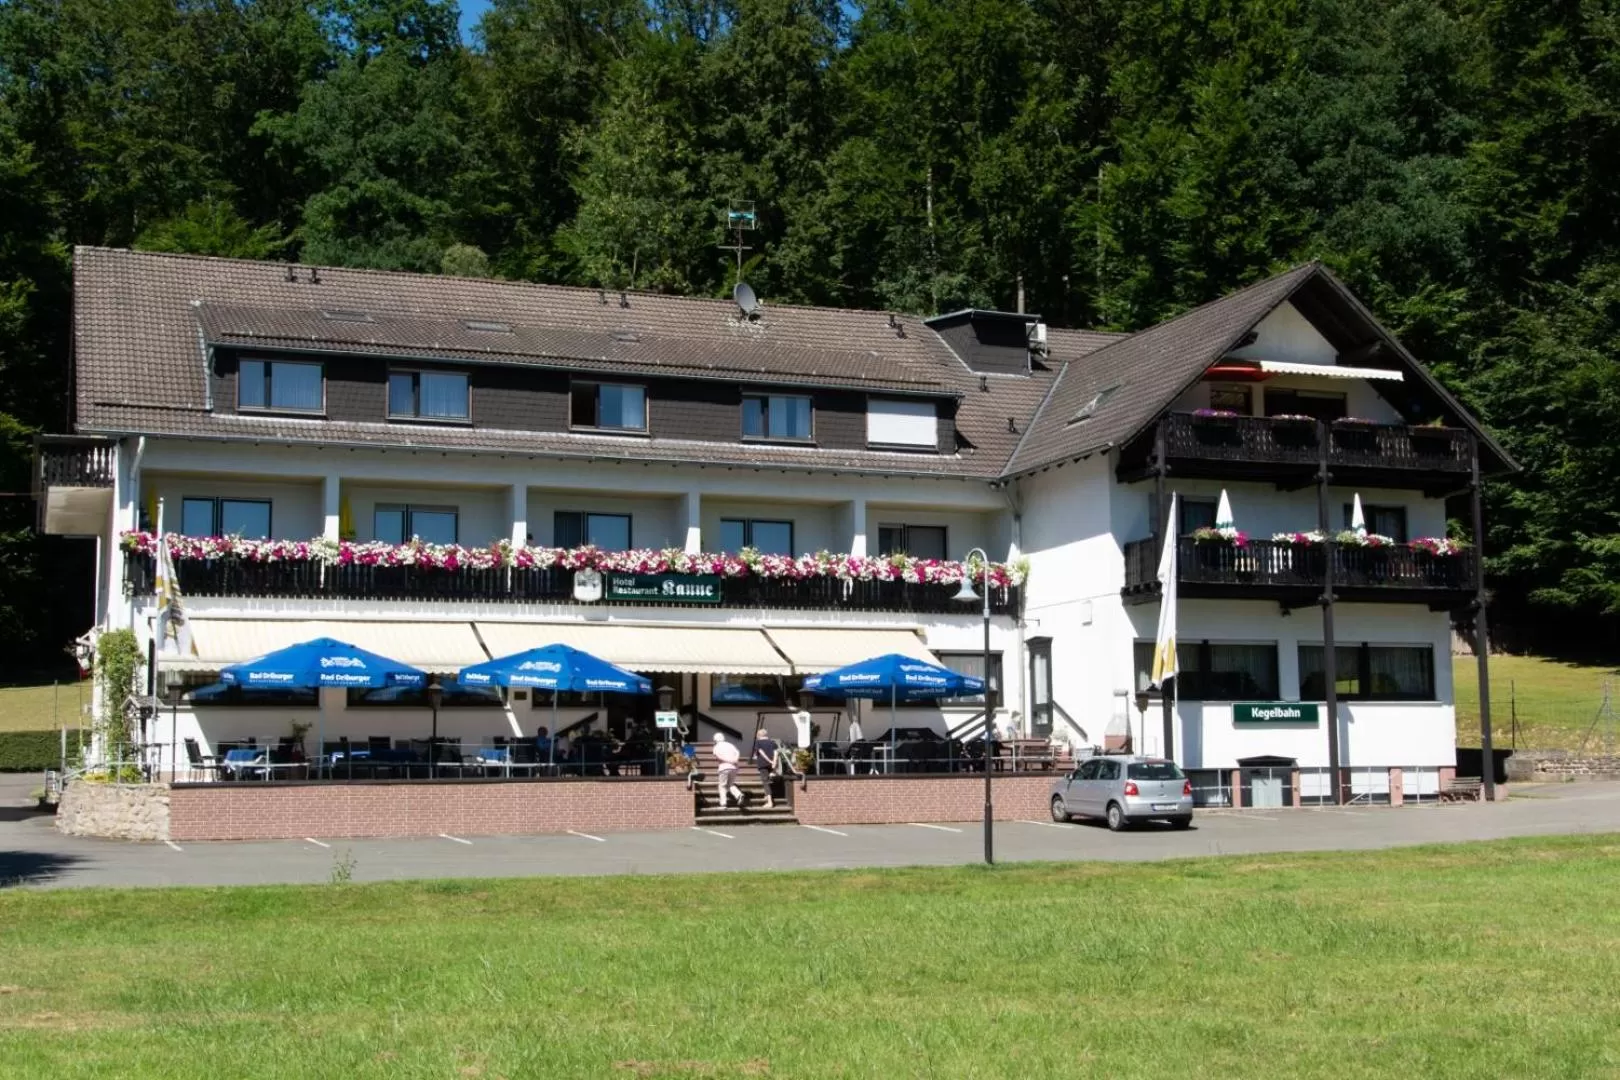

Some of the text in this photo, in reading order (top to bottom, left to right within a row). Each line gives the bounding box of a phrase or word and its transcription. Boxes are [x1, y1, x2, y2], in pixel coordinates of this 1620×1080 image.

[612, 577, 635, 586] Hotel
[612, 586, 658, 595] Restaurant
[249, 672, 294, 681] Bad Driburger
[320, 673, 334, 681] Bad
[335, 673, 371, 683] Driburger
[1251, 707, 1301, 721] Kegelbahn
